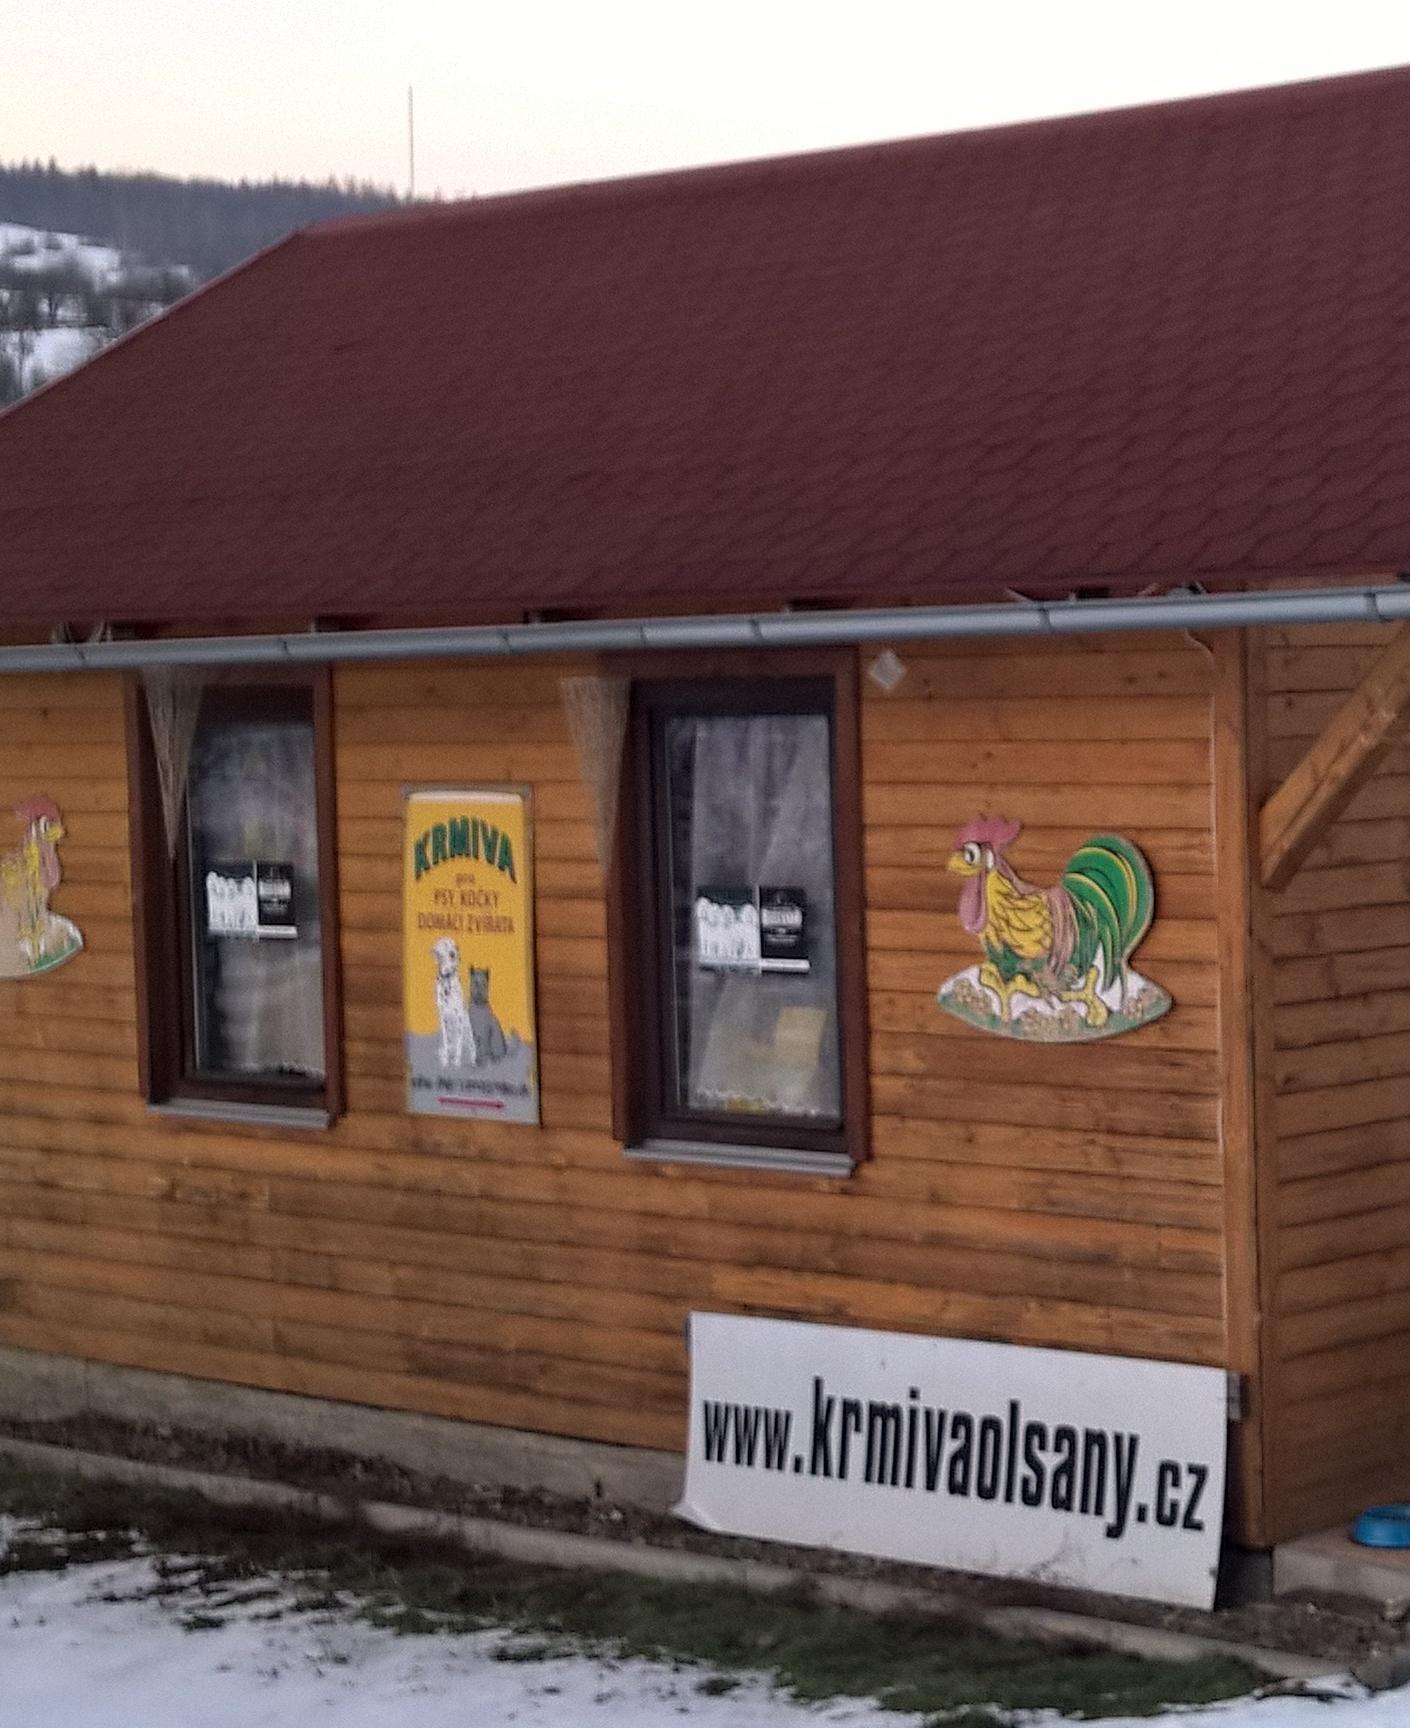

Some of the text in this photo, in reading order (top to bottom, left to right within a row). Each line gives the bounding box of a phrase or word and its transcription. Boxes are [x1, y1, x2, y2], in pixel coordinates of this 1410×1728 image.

[415, 816, 517, 884] KRMIVA
[433, 888, 454, 906] PSY
[703, 1376, 1208, 1538] www.krmivaolsany.cz
